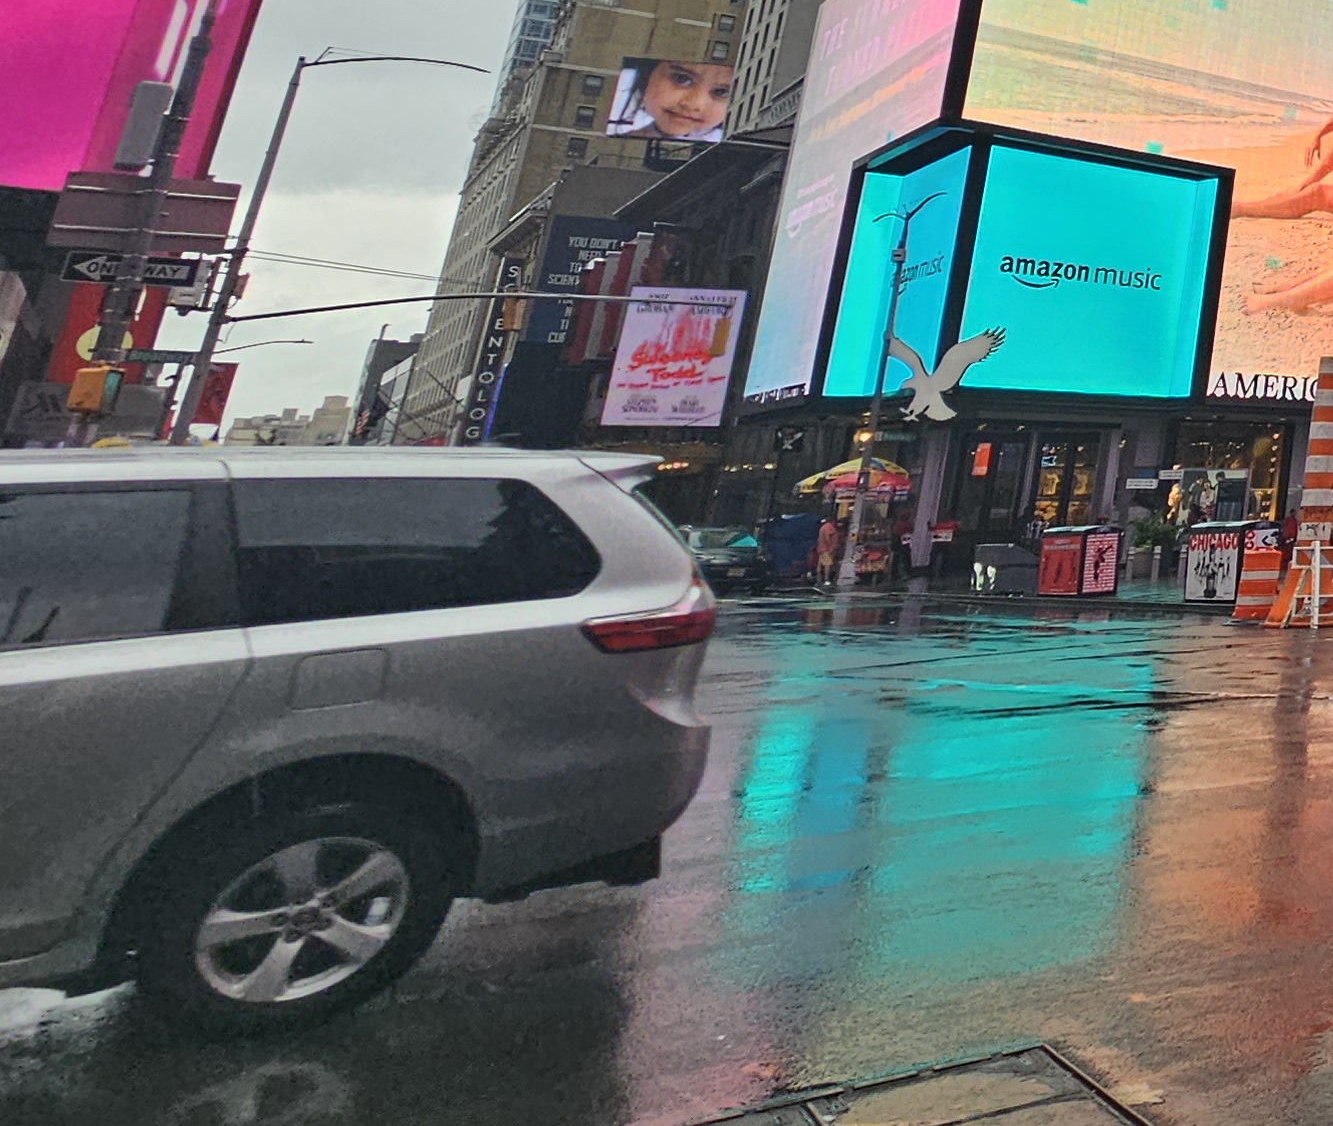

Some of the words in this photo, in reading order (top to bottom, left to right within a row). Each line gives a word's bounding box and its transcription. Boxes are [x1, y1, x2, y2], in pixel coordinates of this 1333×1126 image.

[568, 236, 587, 248] YOU
[1000, 254, 1089, 284] amazon
[1093, 264, 1162, 292] music
[1189, 533, 1239, 551] CHICAGO
